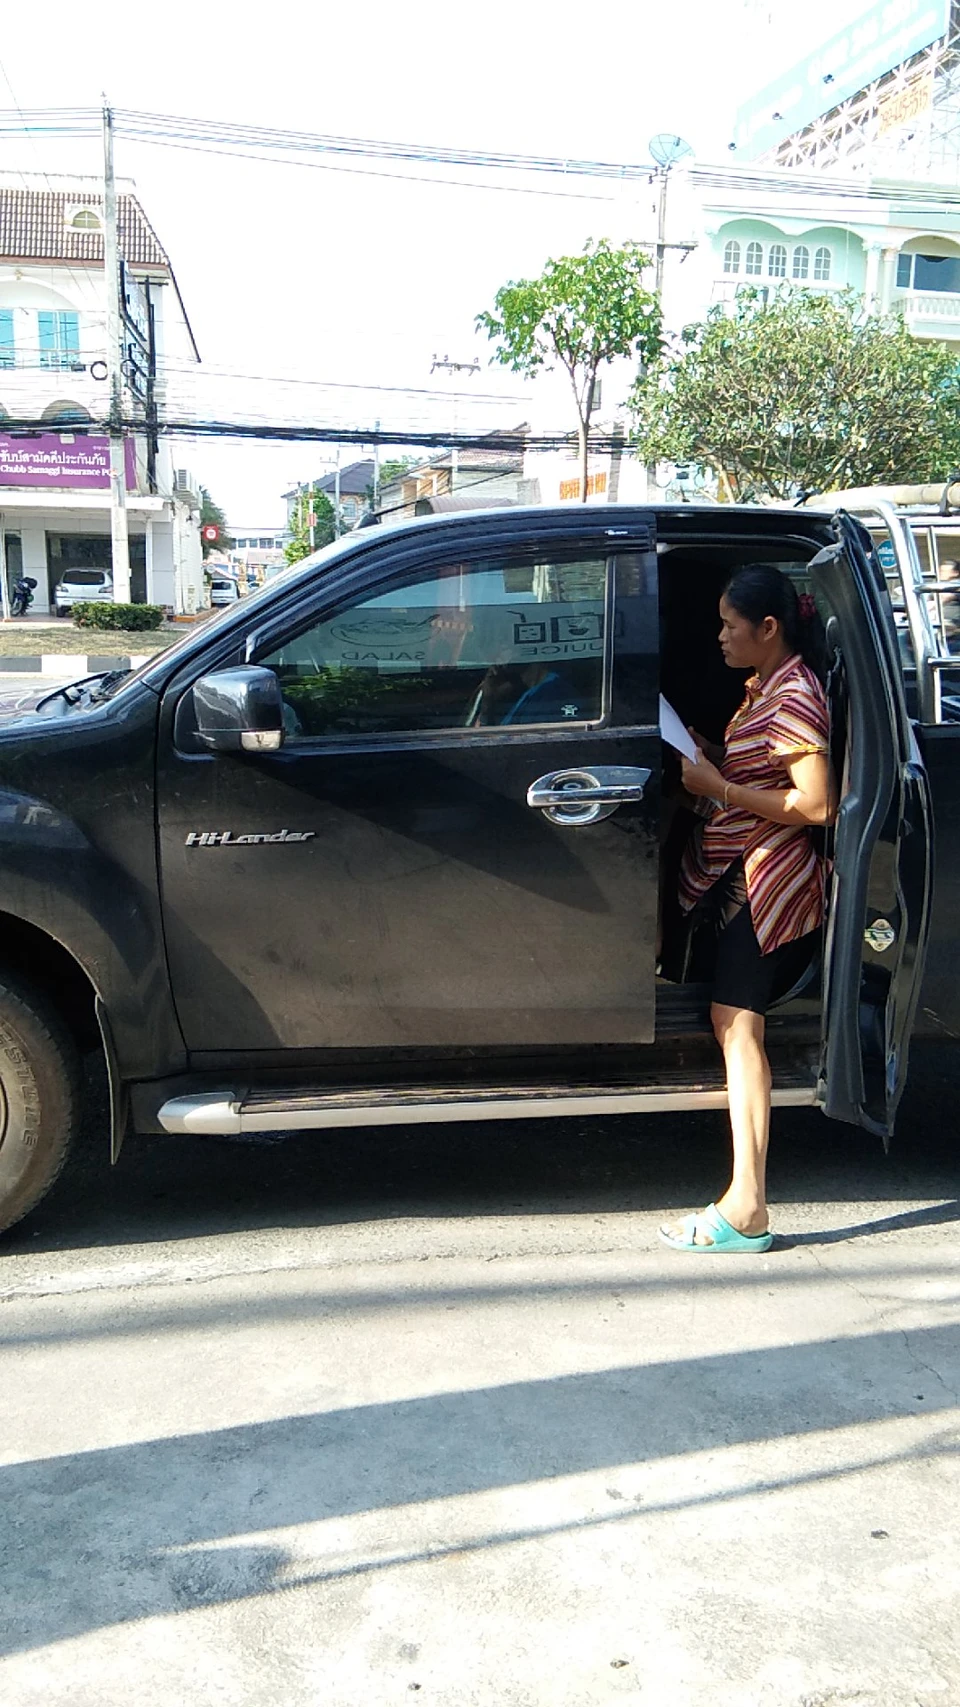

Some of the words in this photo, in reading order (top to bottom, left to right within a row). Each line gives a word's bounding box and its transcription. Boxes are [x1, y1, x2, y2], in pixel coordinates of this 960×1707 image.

[1, 464, 26, 473] Chubb
[27, 466, 60, 477] Samaggi
[62, 467, 100, 476] Insurance
